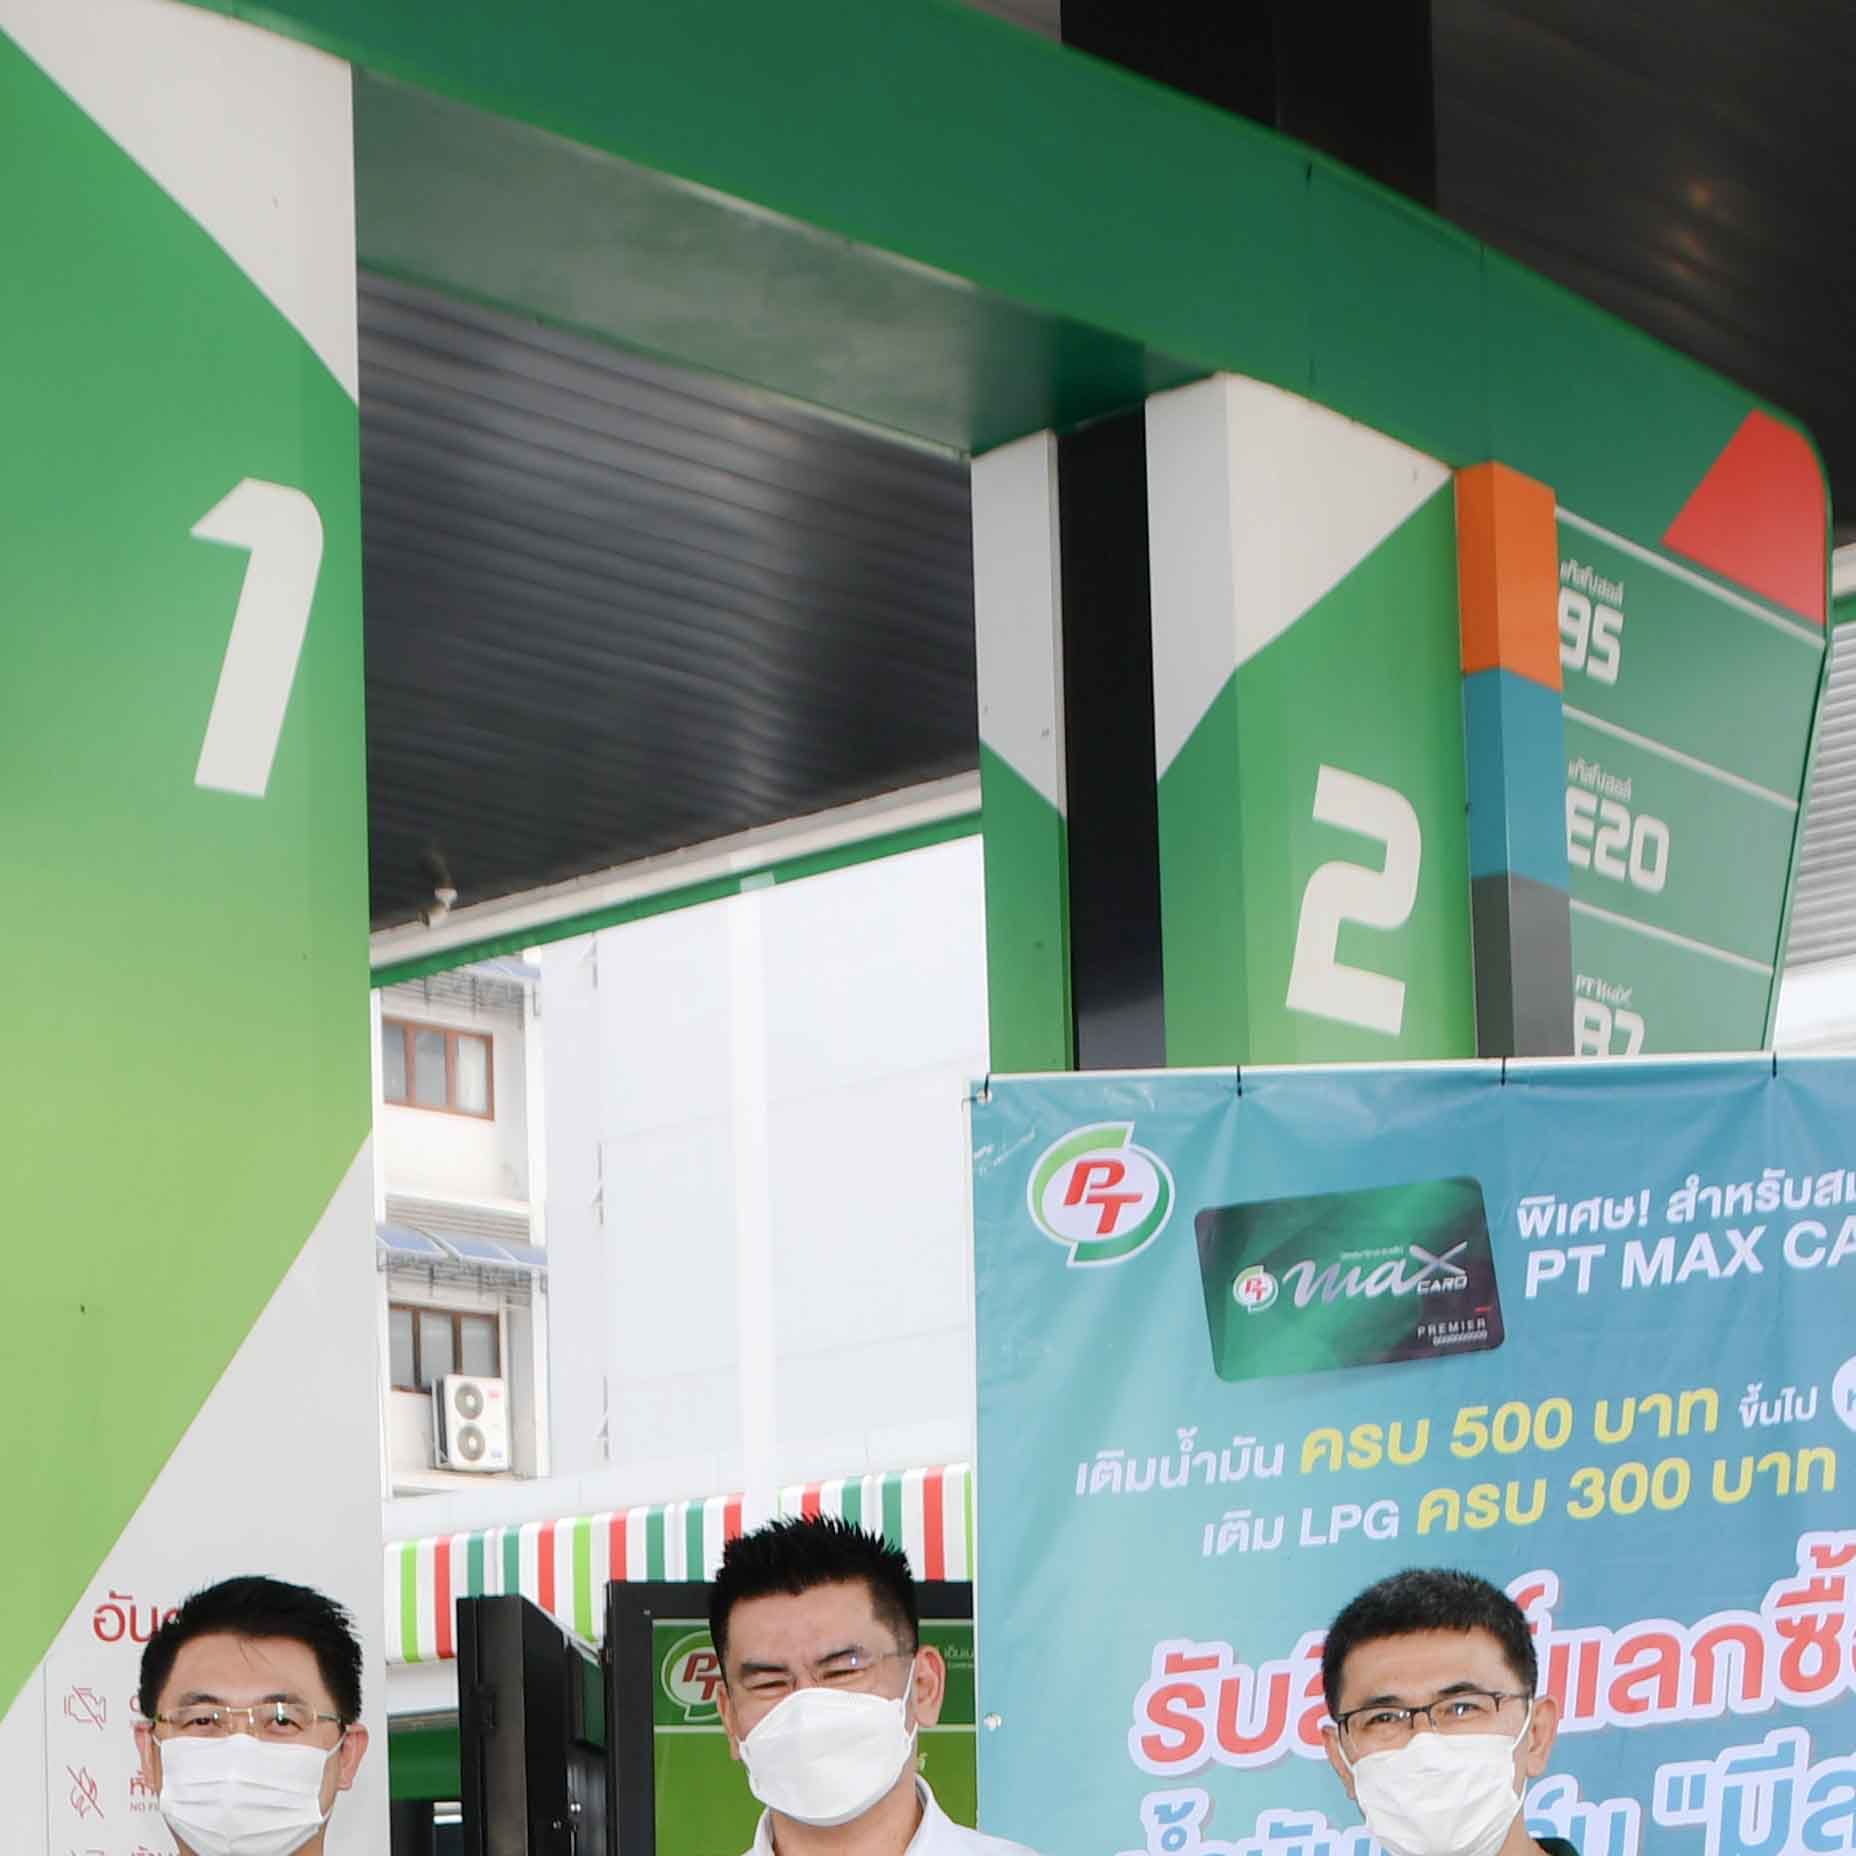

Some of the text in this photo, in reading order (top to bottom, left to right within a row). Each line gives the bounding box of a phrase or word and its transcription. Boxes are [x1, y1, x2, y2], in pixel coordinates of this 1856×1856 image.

[190, 478, 325, 798] 1
[1558, 586, 1624, 686] 95
[1565, 786, 1670, 894] E20
[1285, 763, 1422, 1037] 2
[1063, 1158, 1143, 1235] PT
[1516, 1189, 1650, 1240] พิเศษ!
[1417, 1273, 1468, 1295] CARD
[1525, 1244, 1606, 1299] PT
[1621, 1225, 1767, 1289] MAX
[1417, 1317, 1487, 1338] PREMIER
[1075, 1382, 1819, 1497] เติมน้ำมัน ครบ 500 บาท ขึ้นไป
[1202, 1506, 1285, 1557] เติม
[1298, 1499, 1401, 1547] LPG
[1415, 1477, 1547, 1536] ครบ
[1566, 1457, 1692, 1521] 300
[1710, 1444, 1837, 1507] บาท
